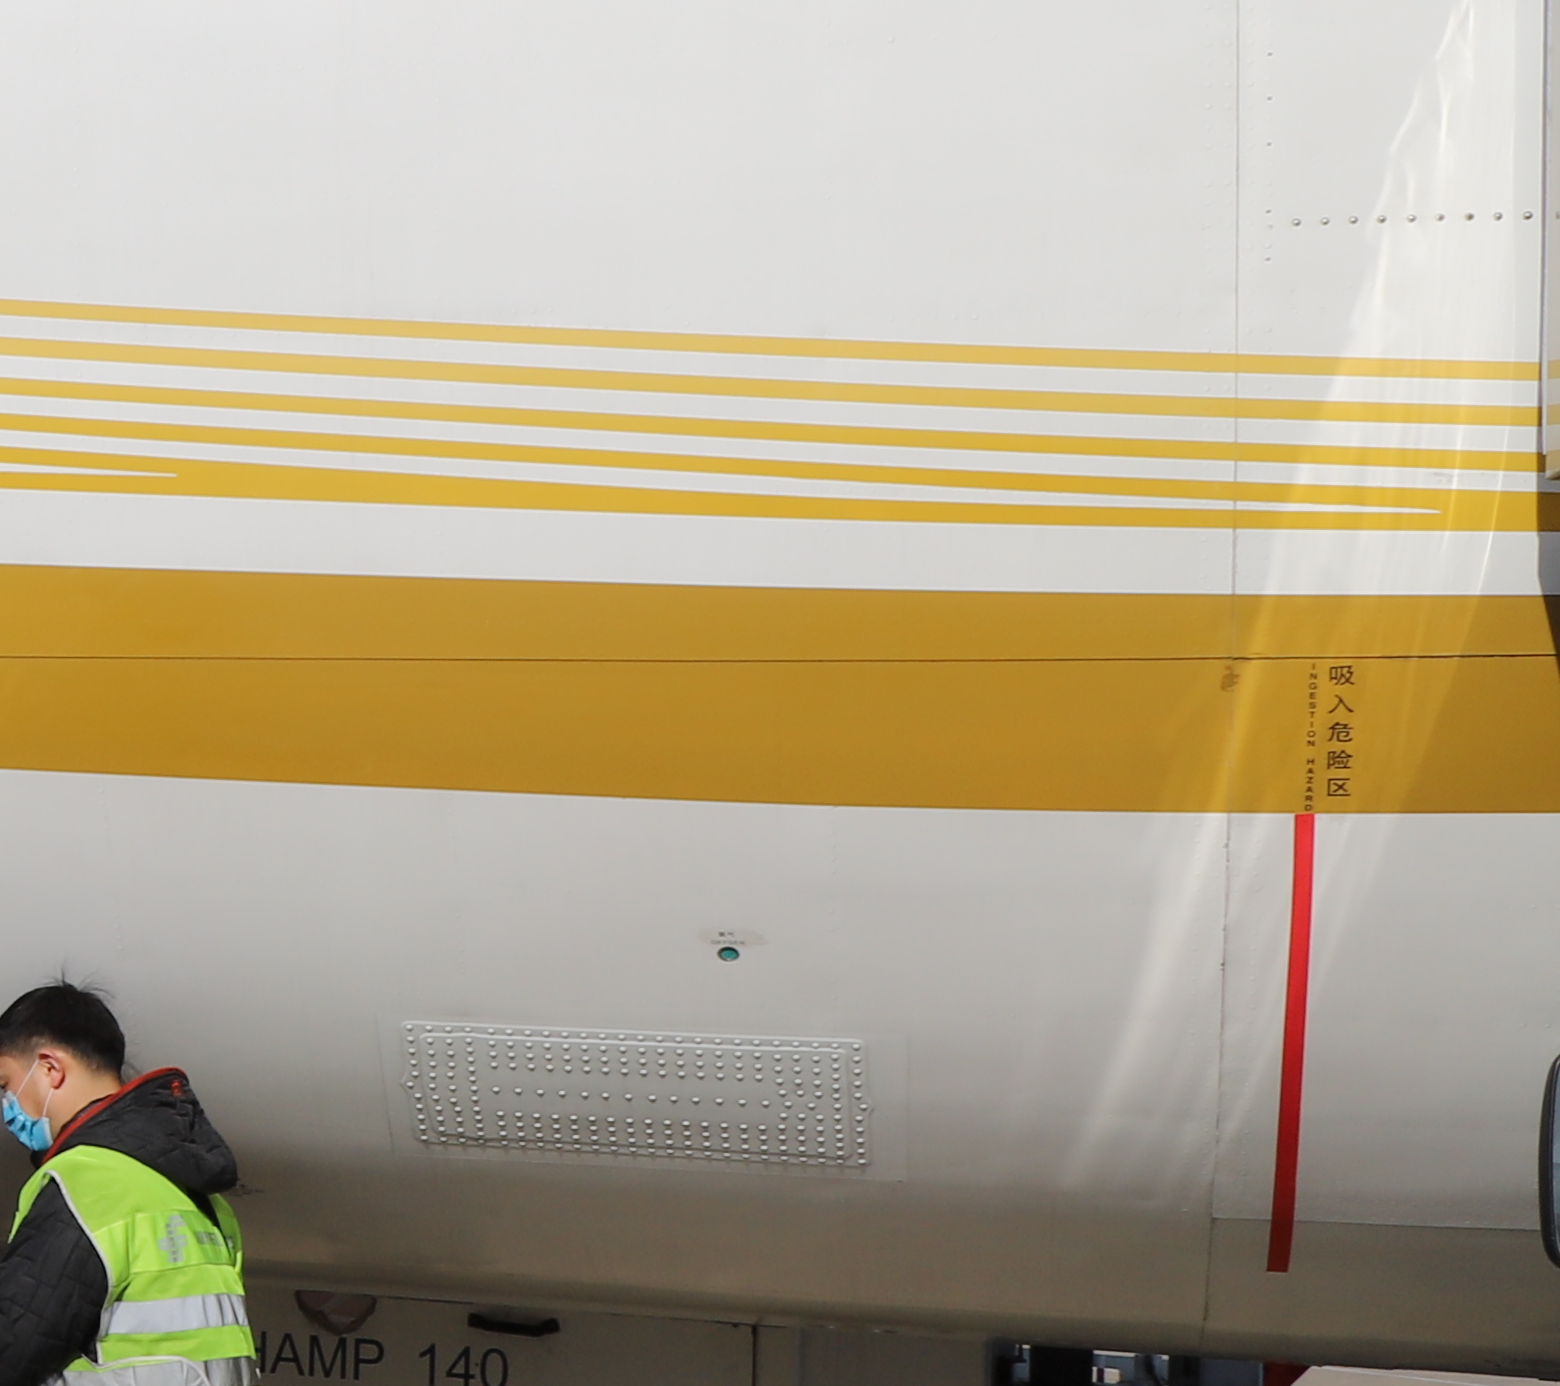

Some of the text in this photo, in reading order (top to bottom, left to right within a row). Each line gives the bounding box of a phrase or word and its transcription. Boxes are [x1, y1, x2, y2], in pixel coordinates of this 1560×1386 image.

[1303, 663, 1318, 811] INGESTION HAZARD
[1326, 665, 1355, 797] 吸入危险区
